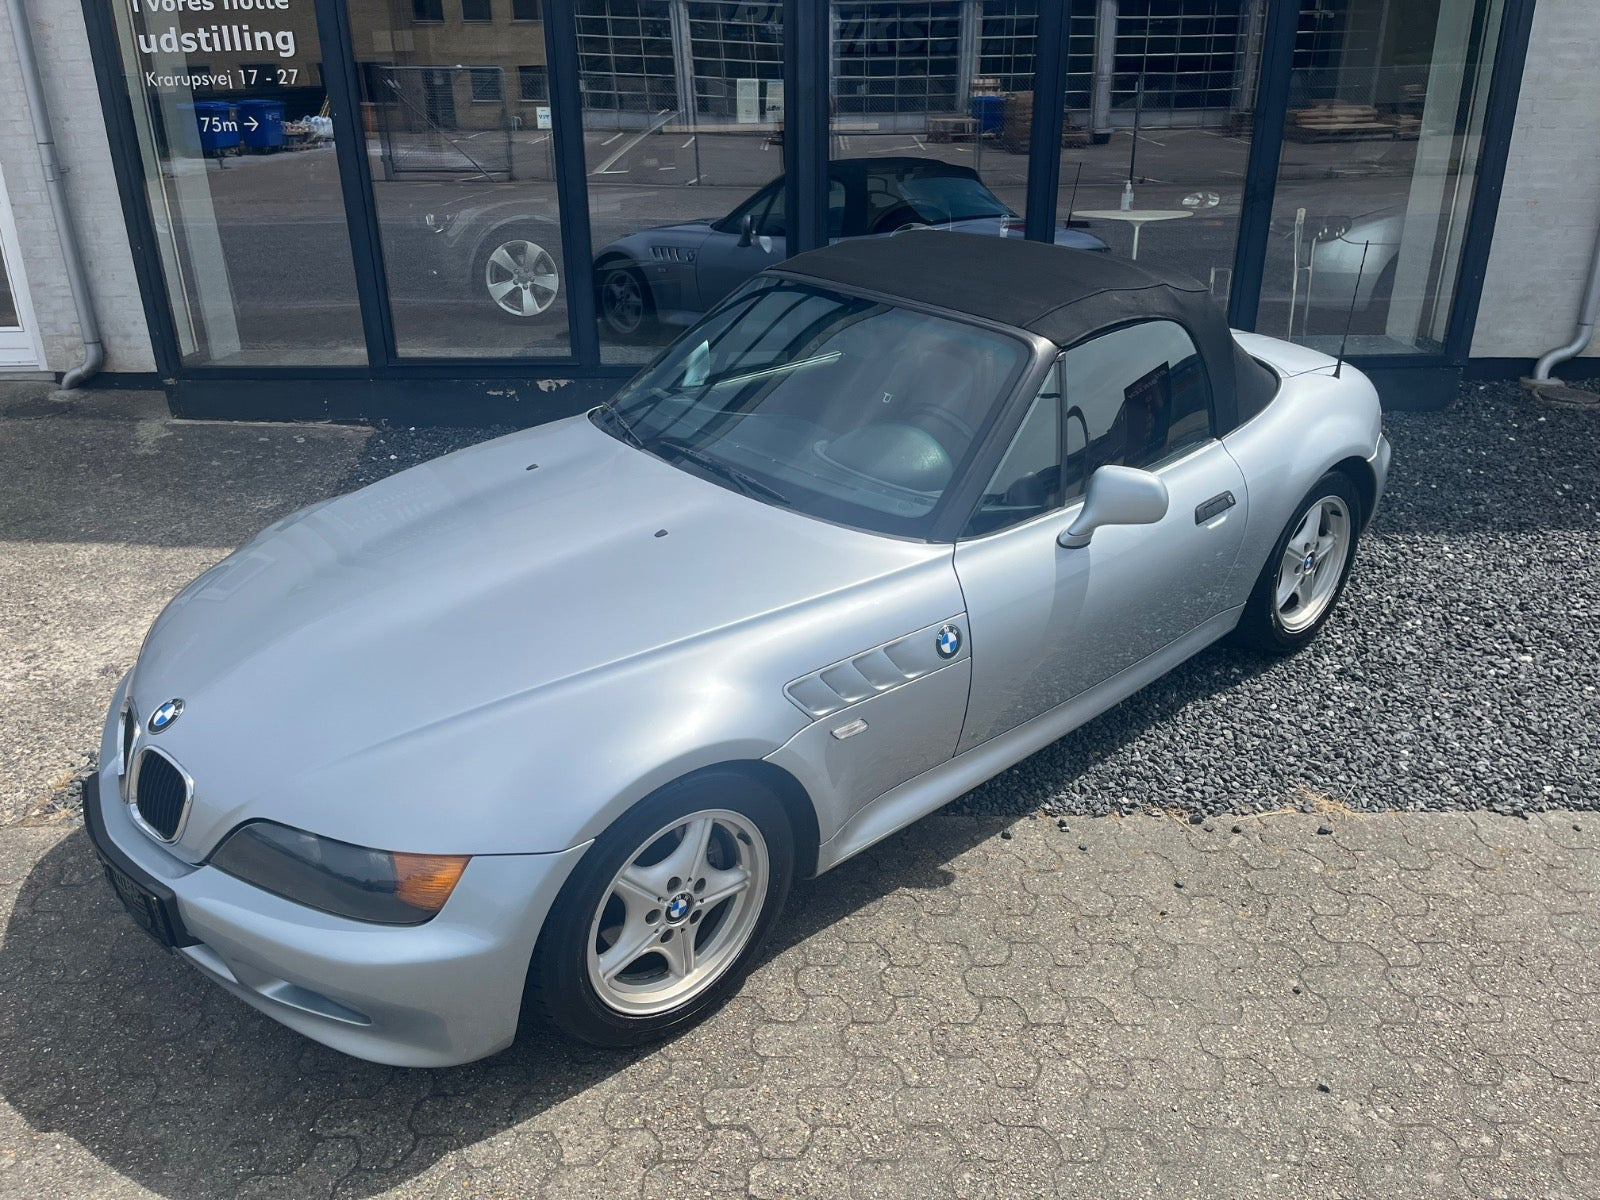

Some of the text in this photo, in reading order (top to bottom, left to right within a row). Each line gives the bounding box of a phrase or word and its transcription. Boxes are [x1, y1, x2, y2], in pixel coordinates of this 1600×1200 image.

[147, 0, 215, 12] vores
[138, 25, 296, 58] udstilling
[145, 70, 233, 90] Krarupsvej
[238, 69, 258, 85] 17
[276, 69, 298, 85] 27
[200, 117, 238, 133] 75m
